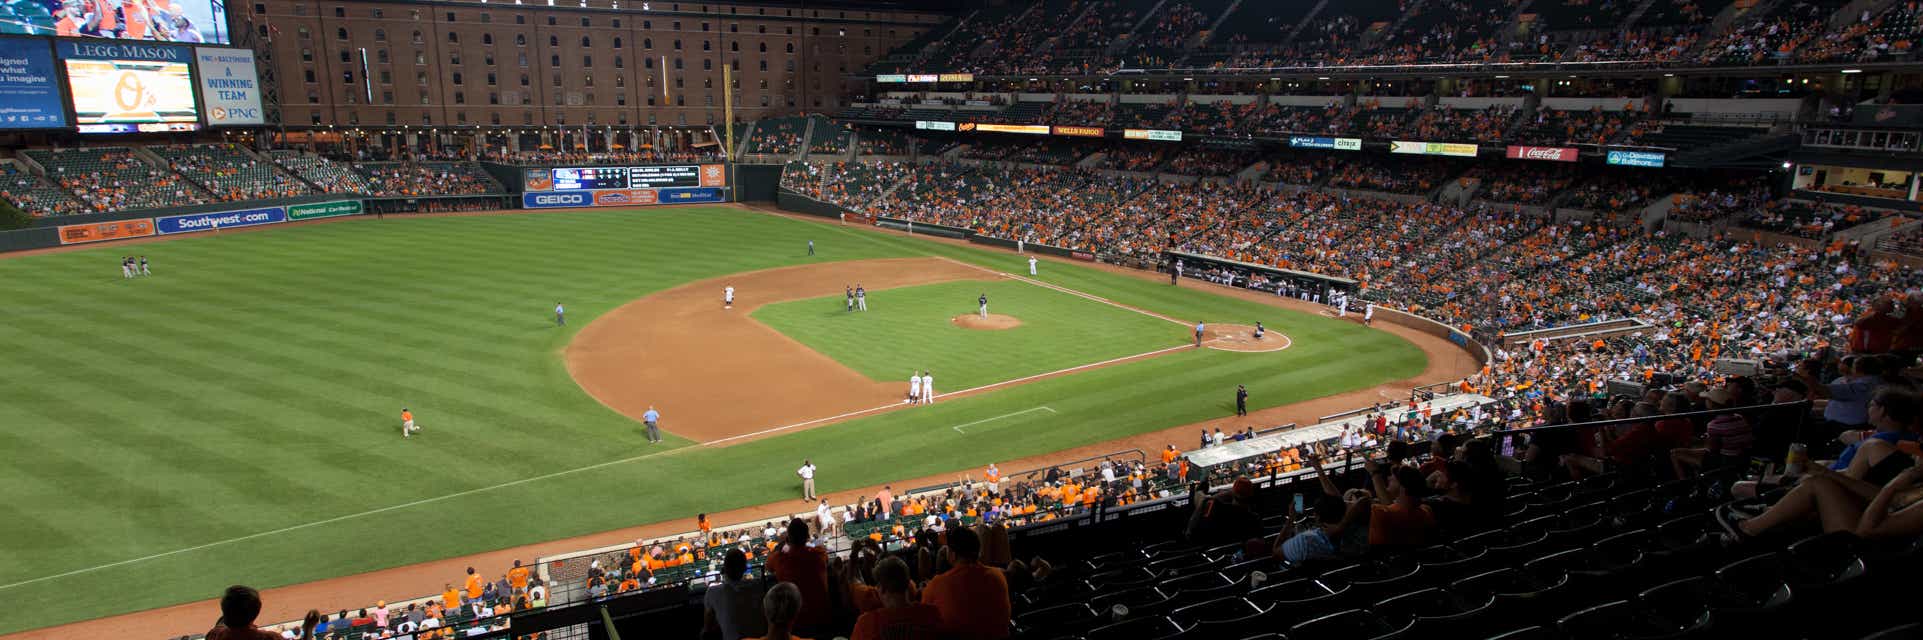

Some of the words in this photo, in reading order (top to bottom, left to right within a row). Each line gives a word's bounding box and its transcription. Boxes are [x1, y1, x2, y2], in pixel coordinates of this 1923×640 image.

[73, 43, 119, 58] LEGG
[122, 45, 177, 60] MASON
[226, 66, 233, 77] A
[7, 74, 47, 84] imagine
[208, 78, 253, 89] WINNING
[217, 90, 247, 101] TEAM
[229, 107, 257, 118] PNC
[535, 194, 583, 205] GEICO
